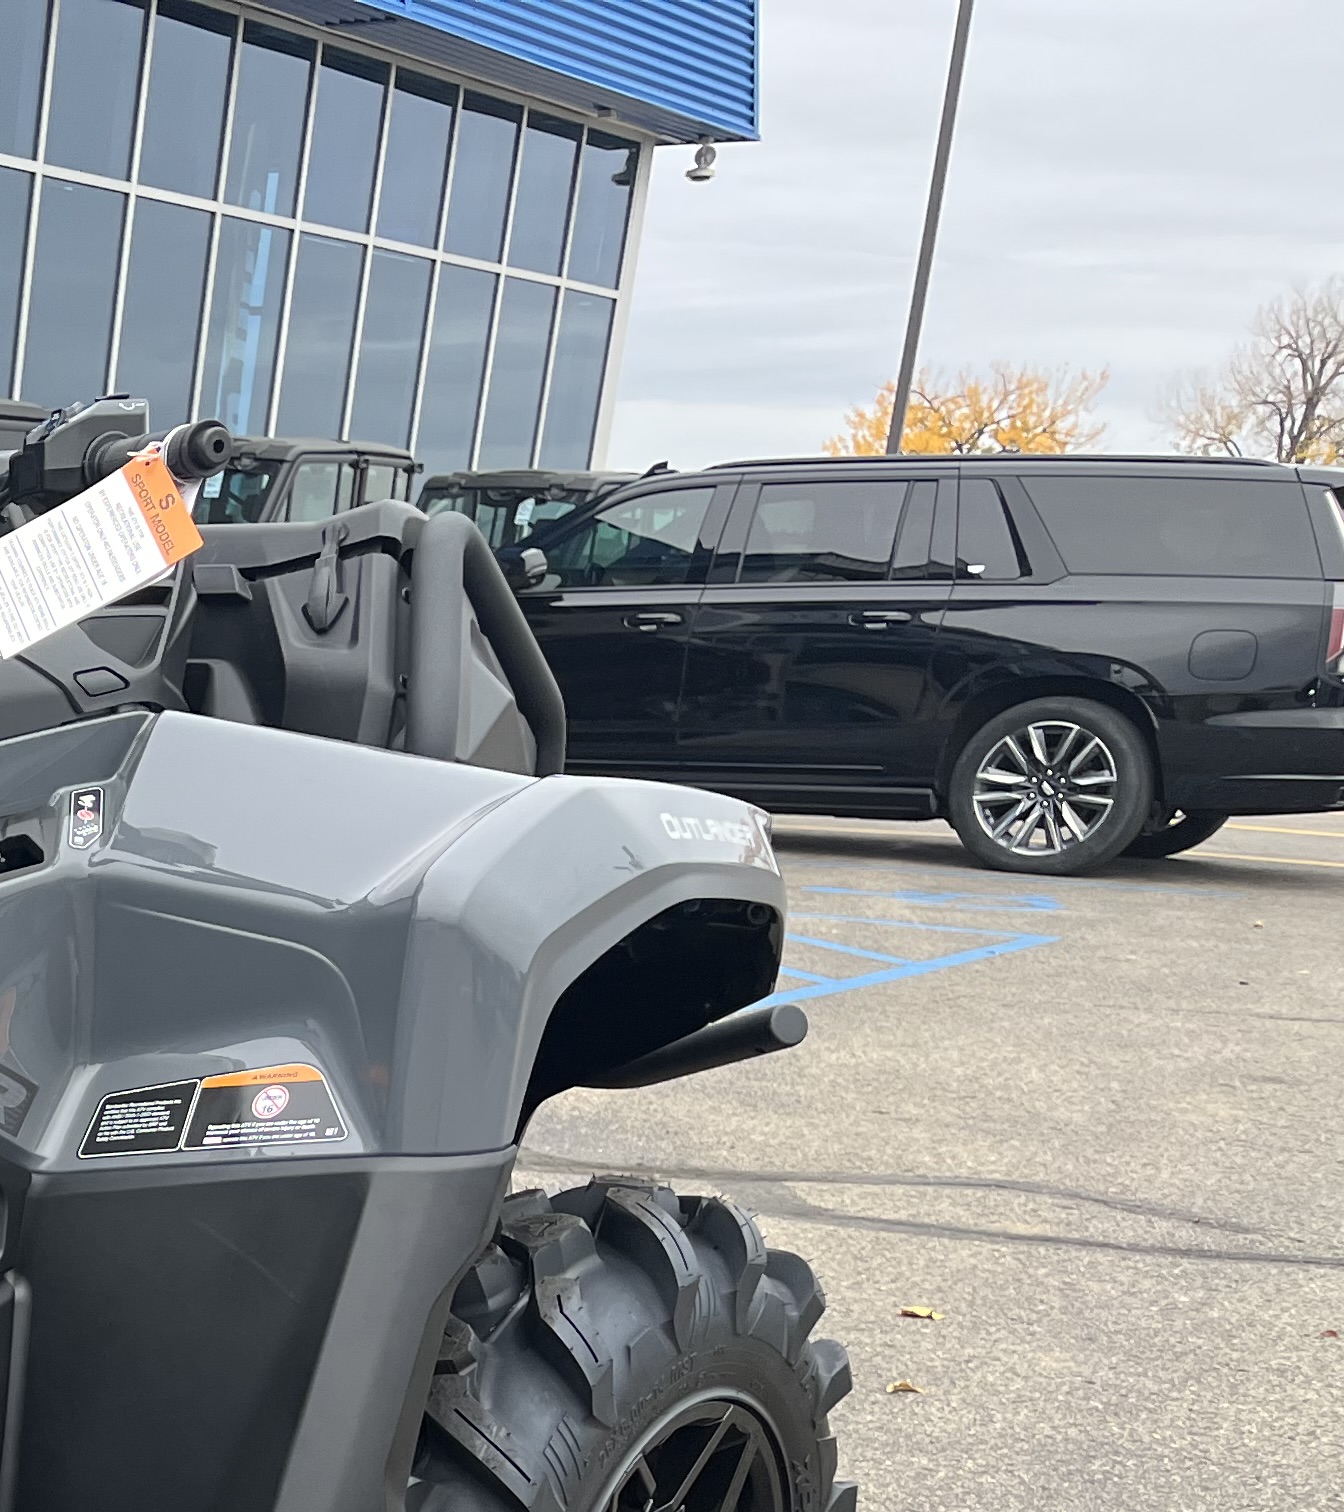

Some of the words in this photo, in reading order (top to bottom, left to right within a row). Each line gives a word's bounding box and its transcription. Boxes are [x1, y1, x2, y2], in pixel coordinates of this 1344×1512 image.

[159, 493, 176, 510] S
[131, 473, 156, 512] SPORT
[151, 512, 177, 556] MODEL
[74, 523, 92, 551] OPERATOR
[262, 1104, 274, 1114] 16
